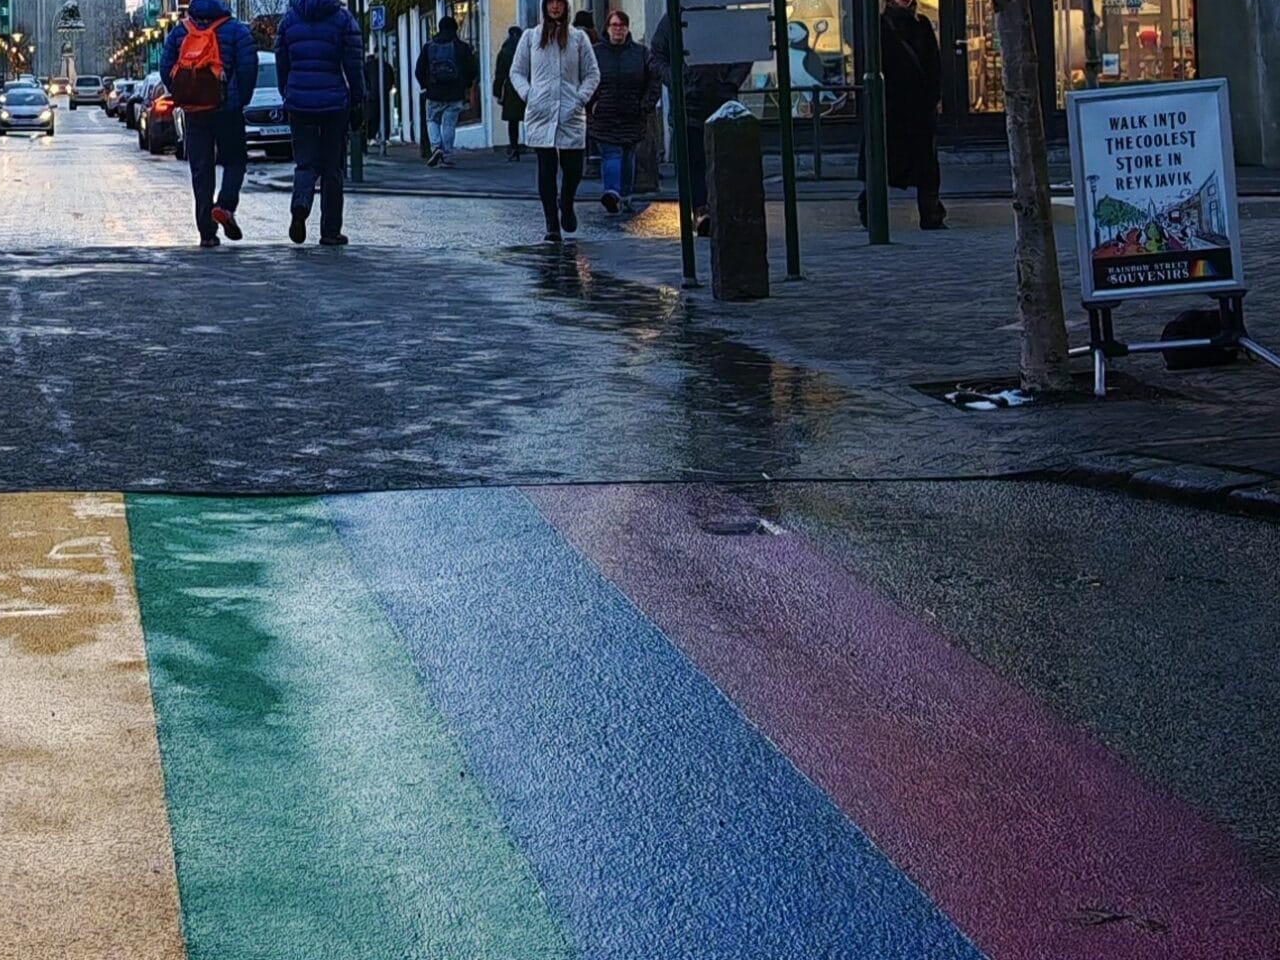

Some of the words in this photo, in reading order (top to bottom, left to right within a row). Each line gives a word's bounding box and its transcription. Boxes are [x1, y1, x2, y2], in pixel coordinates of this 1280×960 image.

[1109, 115, 1147, 130] WALK
[1153, 111, 1187, 129] INTO
[1105, 138, 1132, 155] THE
[1136, 131, 1196, 149] COOLEST
[1116, 156, 1162, 174] STORE
[1168, 152, 1182, 166] IN
[1116, 171, 1192, 191] REYKJAVIK
[1108, 264, 1150, 274] RAINBOW
[1153, 261, 1189, 270] STREET
[1110, 268, 1190, 285] SOUVENIRS
